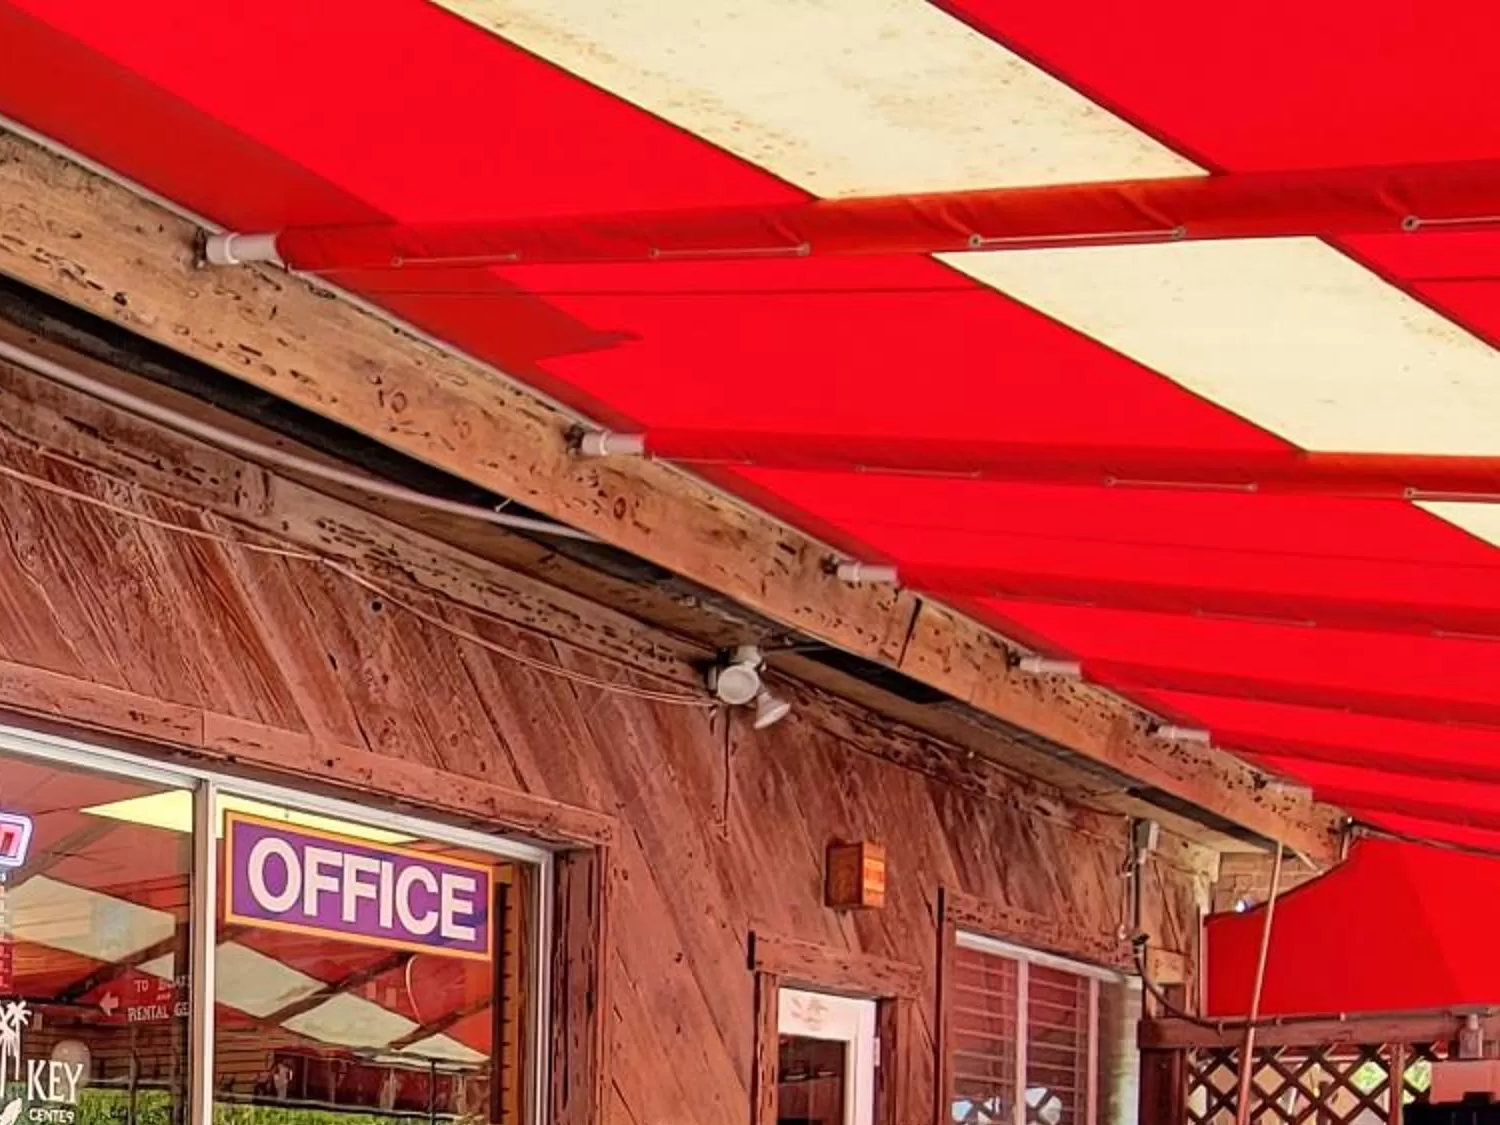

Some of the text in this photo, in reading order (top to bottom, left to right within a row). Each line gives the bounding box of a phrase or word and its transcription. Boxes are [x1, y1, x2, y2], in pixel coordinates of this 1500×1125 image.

[248, 837, 477, 941] OFFICE
[128, 1004, 170, 1022] RENTAL
[28, 1059, 83, 1105] KEY
[29, 1107, 75, 1123] CENTER
